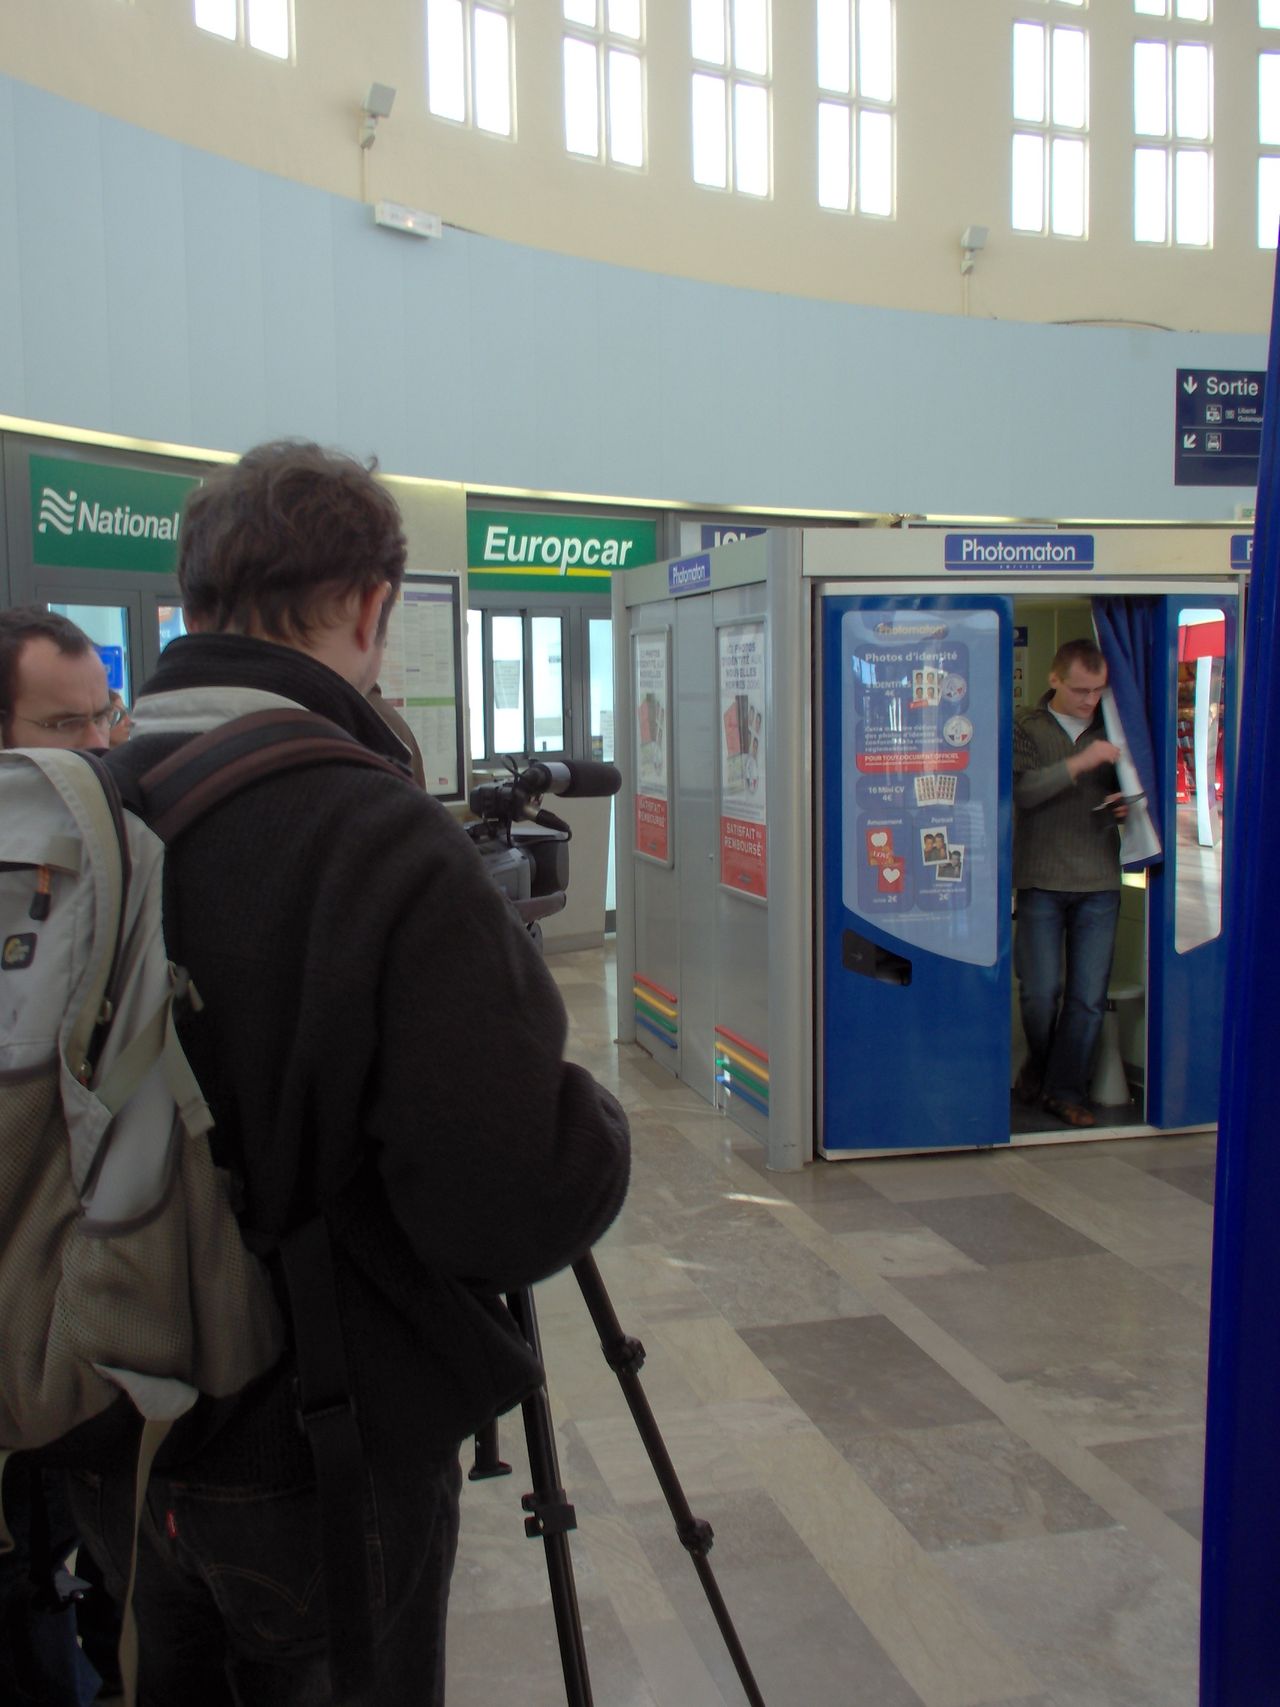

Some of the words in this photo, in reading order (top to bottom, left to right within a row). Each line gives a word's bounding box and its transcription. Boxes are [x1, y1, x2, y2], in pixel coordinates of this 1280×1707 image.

[1206, 376, 1259, 396] Sortie
[78, 500, 180, 541] National
[483, 525, 633, 576] Europcar
[962, 538, 1076, 562] Photomaton
[672, 564, 706, 585] Photomaton
[865, 652, 903, 663] Photos
[905, 650, 958, 662] d'identité
[895, 785, 905, 794] CV
[726, 823, 756, 840] SATISFAIT
[724, 836, 762, 857] REMBOURSÉ
[887, 895, 898, 904] 2€
